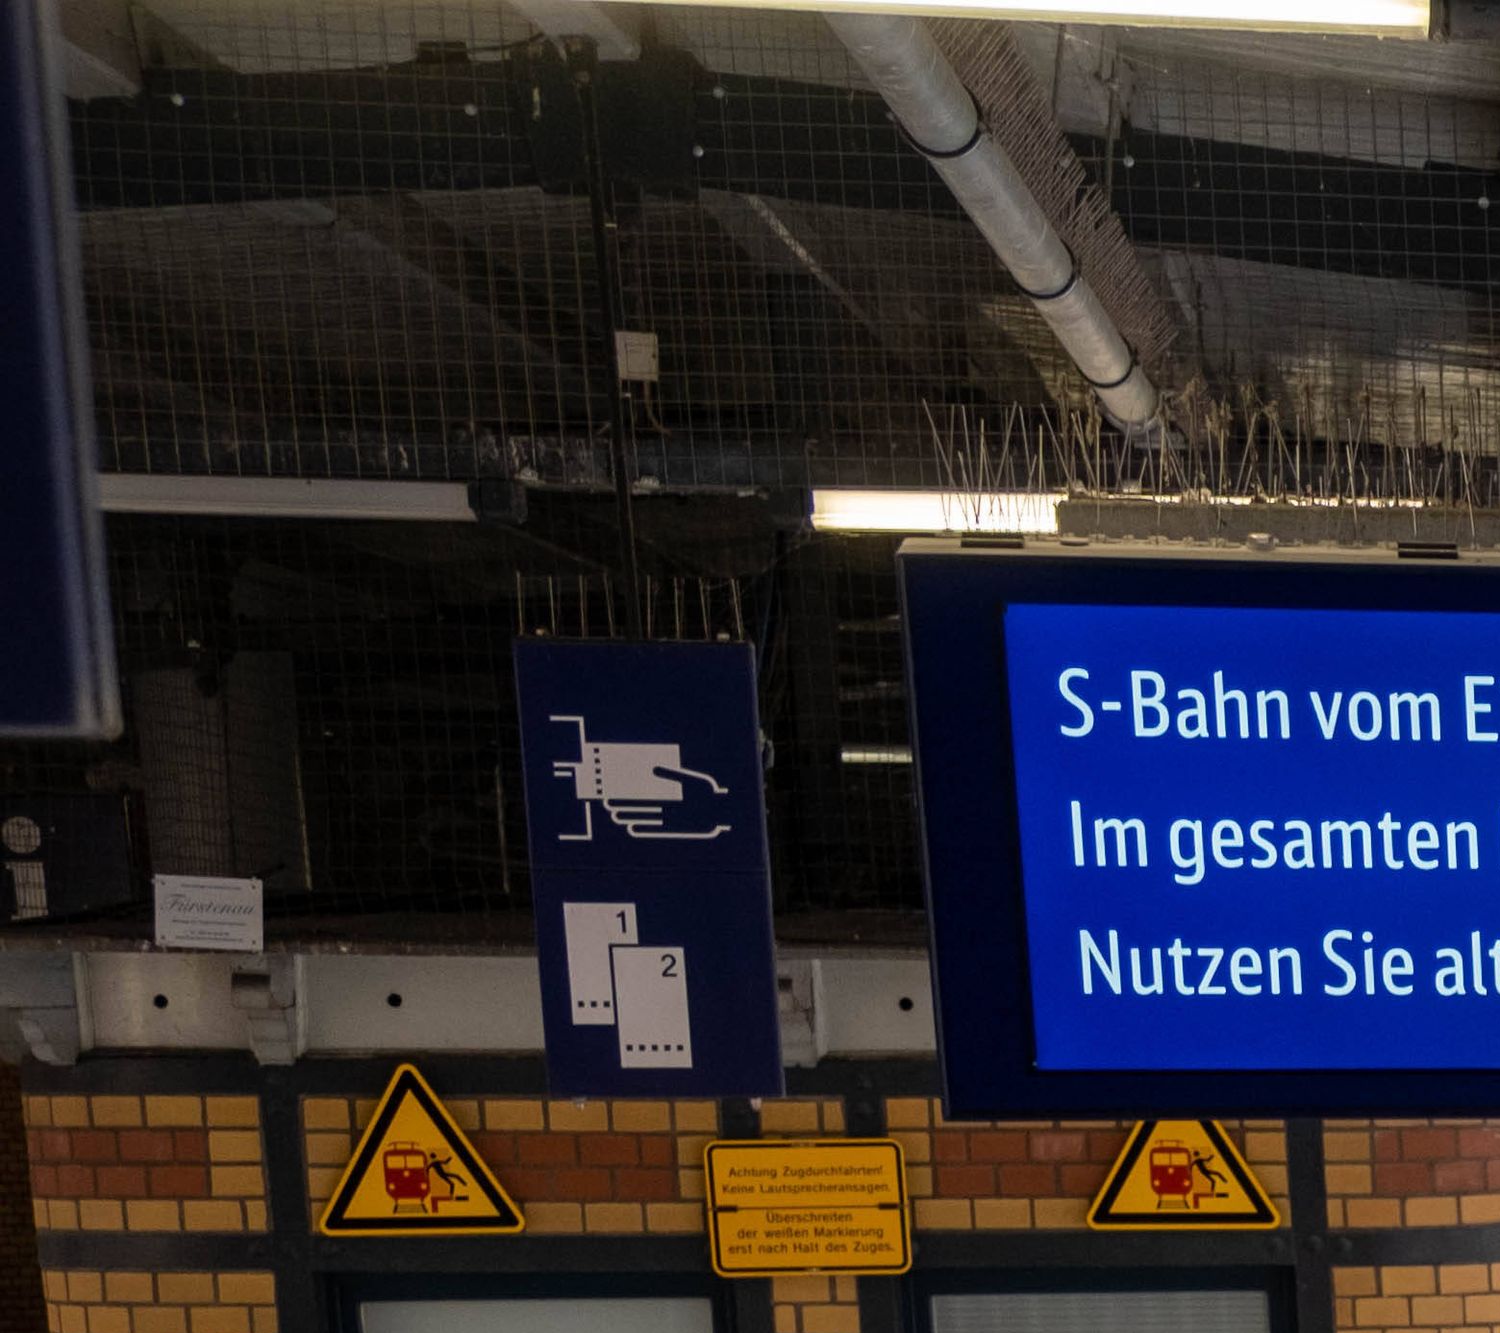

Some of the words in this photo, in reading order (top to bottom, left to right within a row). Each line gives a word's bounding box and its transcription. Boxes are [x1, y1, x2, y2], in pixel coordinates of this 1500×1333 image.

[1059, 668, 1290, 738] S-Bahn
[1310, 692, 1440, 740] vom
[1071, 801, 1147, 866] Im
[1170, 813, 1478, 884] gesamten
[1080, 930, 1302, 995] Nutzen
[1324, 930, 1413, 995] Sie
[728, 1166, 777, 1179] Achtung
[782, 1165, 884, 1180] Zugdurchfahrten!
[722, 1183, 755, 1194] Keine
[766, 1211, 853, 1224] Überschreiten
[737, 1228, 757, 1240] der
[765, 1227, 809, 1239] weißen
[814, 1226, 884, 1241] Markierung
[728, 1244, 752, 1255] erst
[758, 1243, 788, 1255] nach
[793, 1242, 819, 1253] Halt
[825, 1242, 847, 1253] des
[853, 1241, 895, 1255] Zuges.
